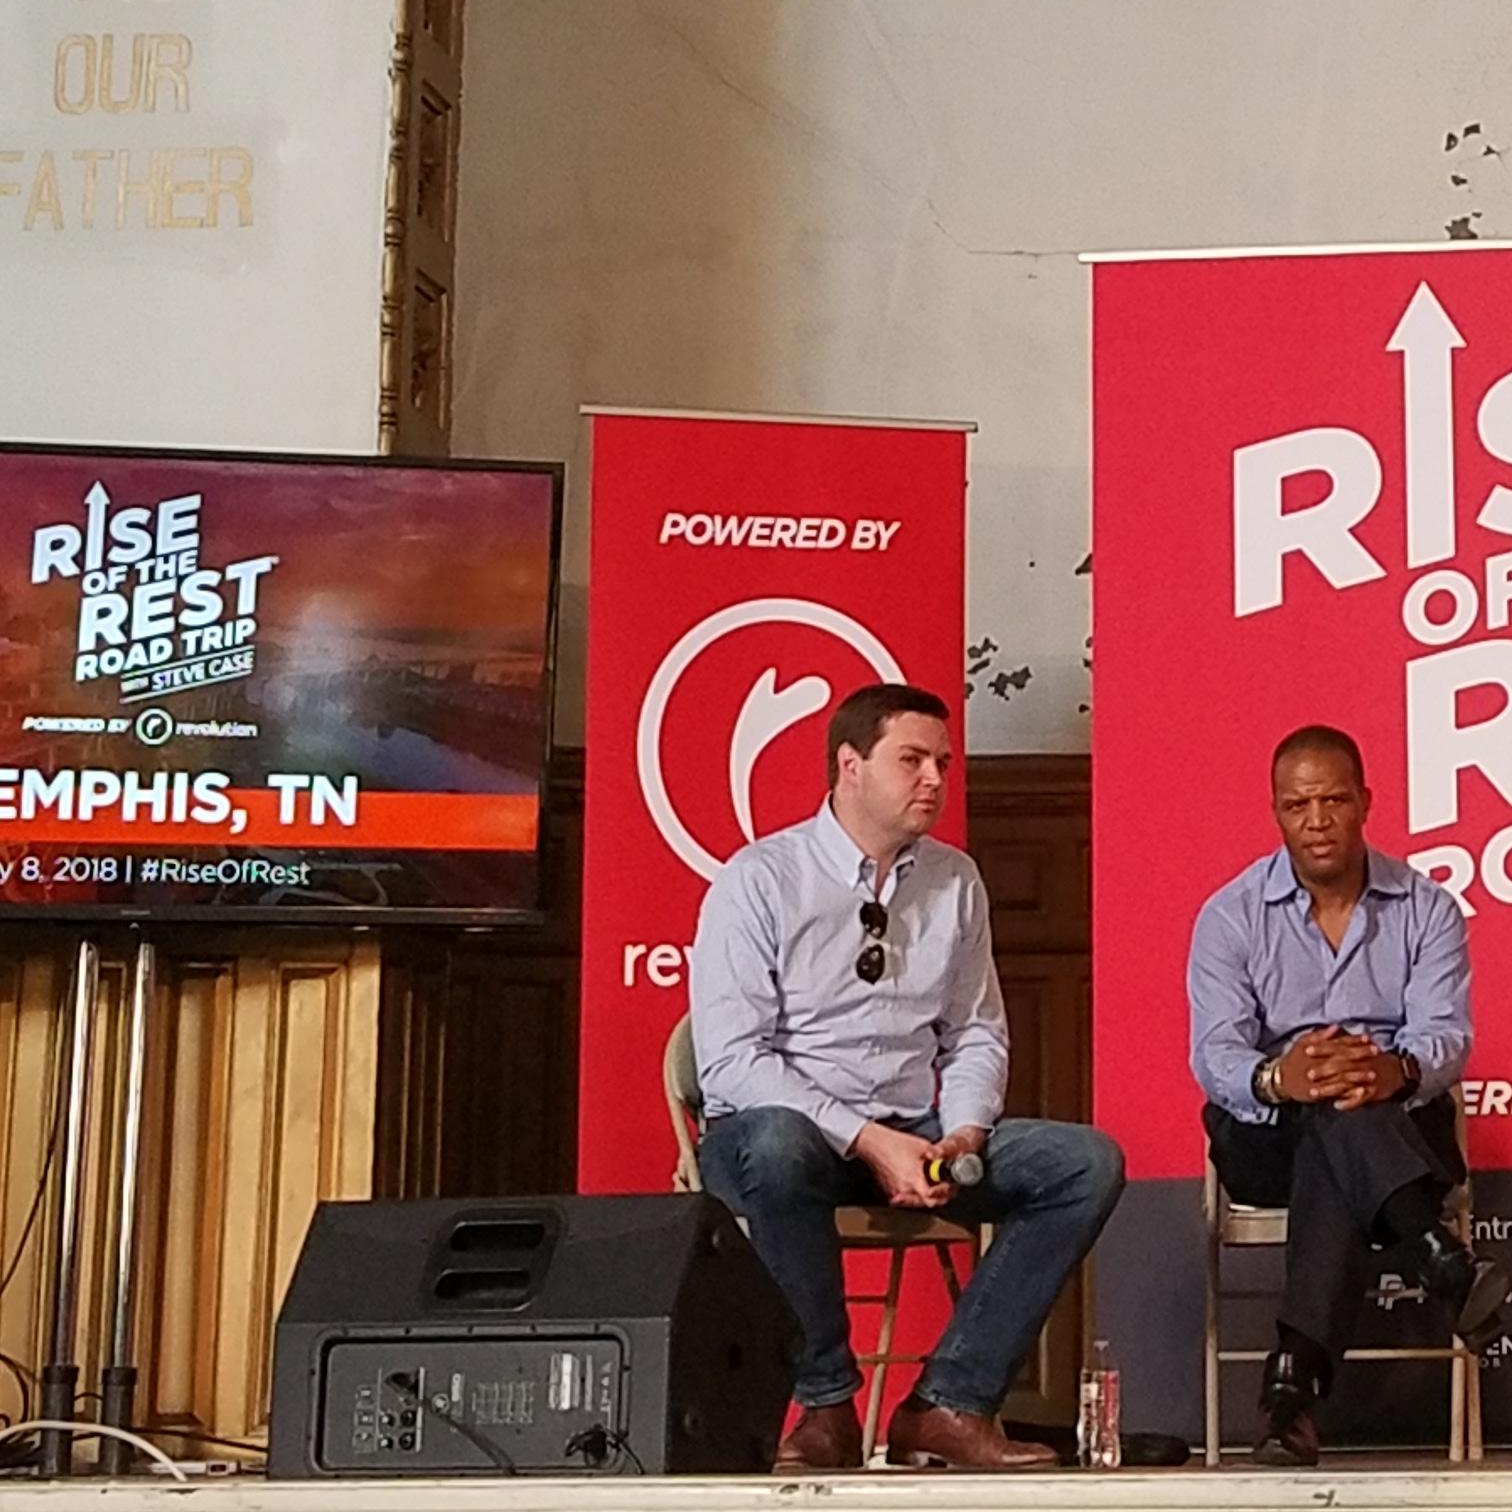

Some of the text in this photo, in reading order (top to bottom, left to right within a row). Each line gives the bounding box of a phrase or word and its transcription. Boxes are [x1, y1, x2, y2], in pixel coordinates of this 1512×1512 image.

[54, 33, 193, 115] OUR
[31, 480, 202, 585] RISE
[659, 513, 901, 551] POWERED BY
[82, 549, 199, 595] OF THE
[75, 618, 257, 683] ROAD TRIP
[208, 650, 255, 677] CASE
[175, 720, 258, 737] revolution
[0, 768, 359, 835] EMPHIS, TN
[53, 856, 118, 883] 2018
[140, 857, 311, 886] #RiseOfRest
[1481, 1356, 1501, 1368] OR
